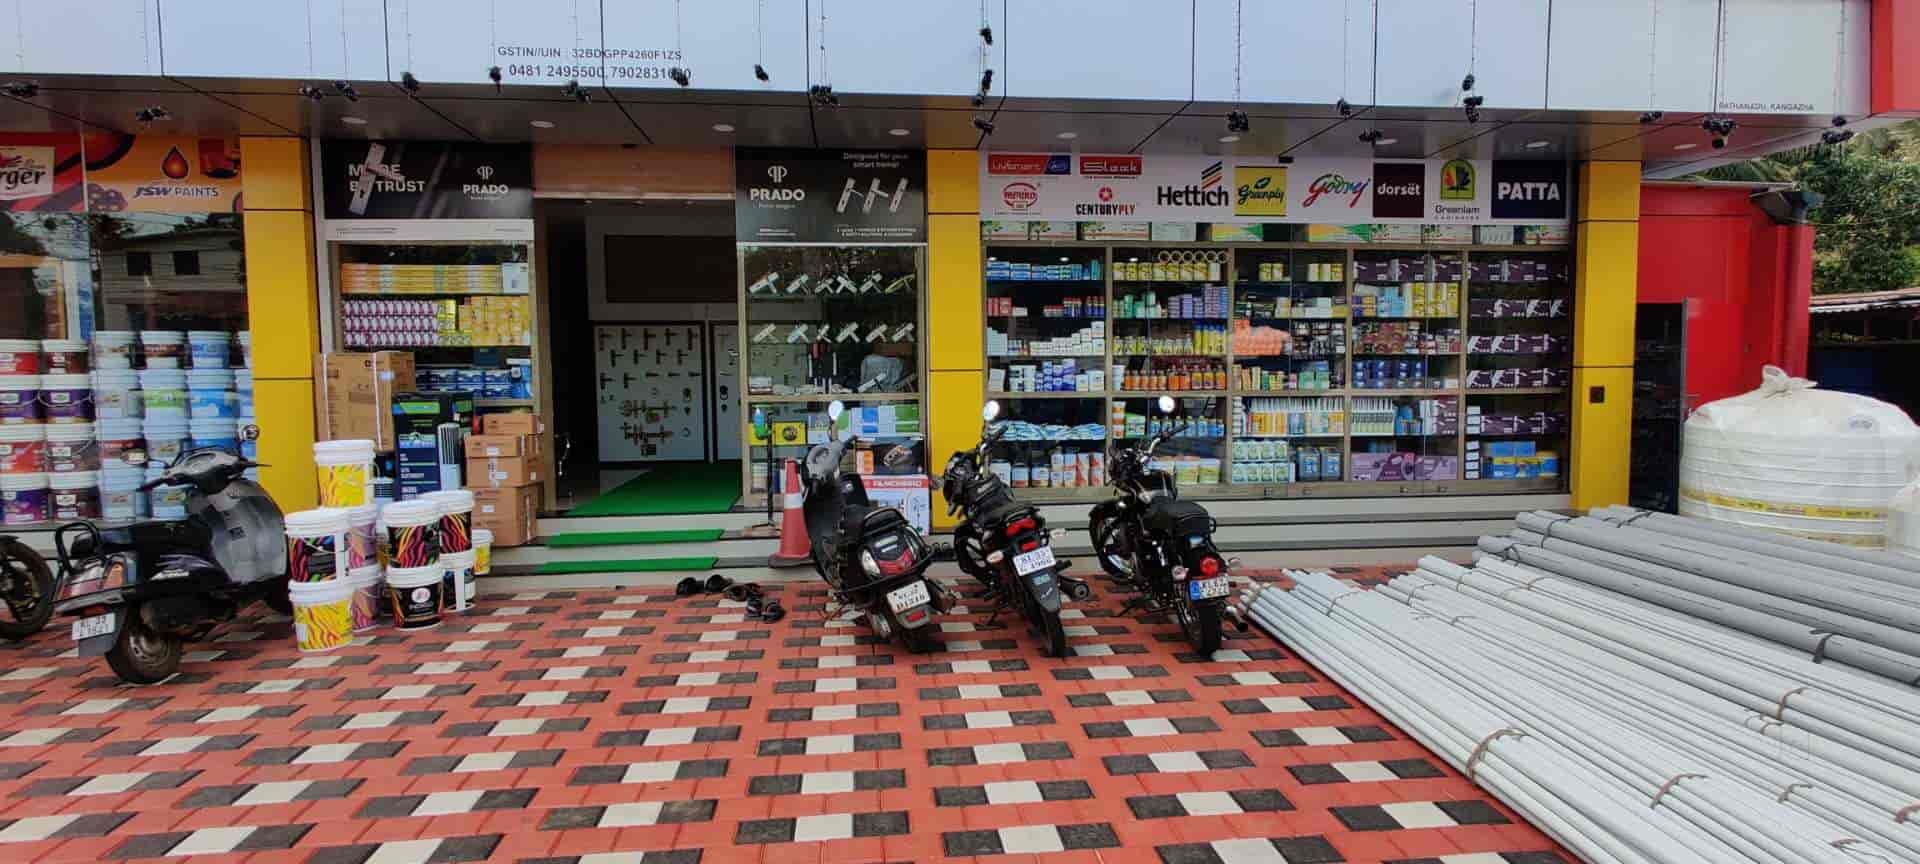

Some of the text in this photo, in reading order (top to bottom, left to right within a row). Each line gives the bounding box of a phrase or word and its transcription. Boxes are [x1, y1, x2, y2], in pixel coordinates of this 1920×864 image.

[509, 64, 541, 77] 0481
[133, 187, 218, 198] JSW PAINTS
[376, 180, 425, 192] TRUST
[462, 184, 509, 195] PRADO
[1302, 174, 1371, 208] Godrej
[1498, 182, 1560, 200] PATTA
[750, 188, 806, 201] PRADO
[1157, 185, 1229, 206] Hettich
[1075, 203, 1136, 216] CENTURYPLY
[1434, 204, 1480, 214] Greenlam
